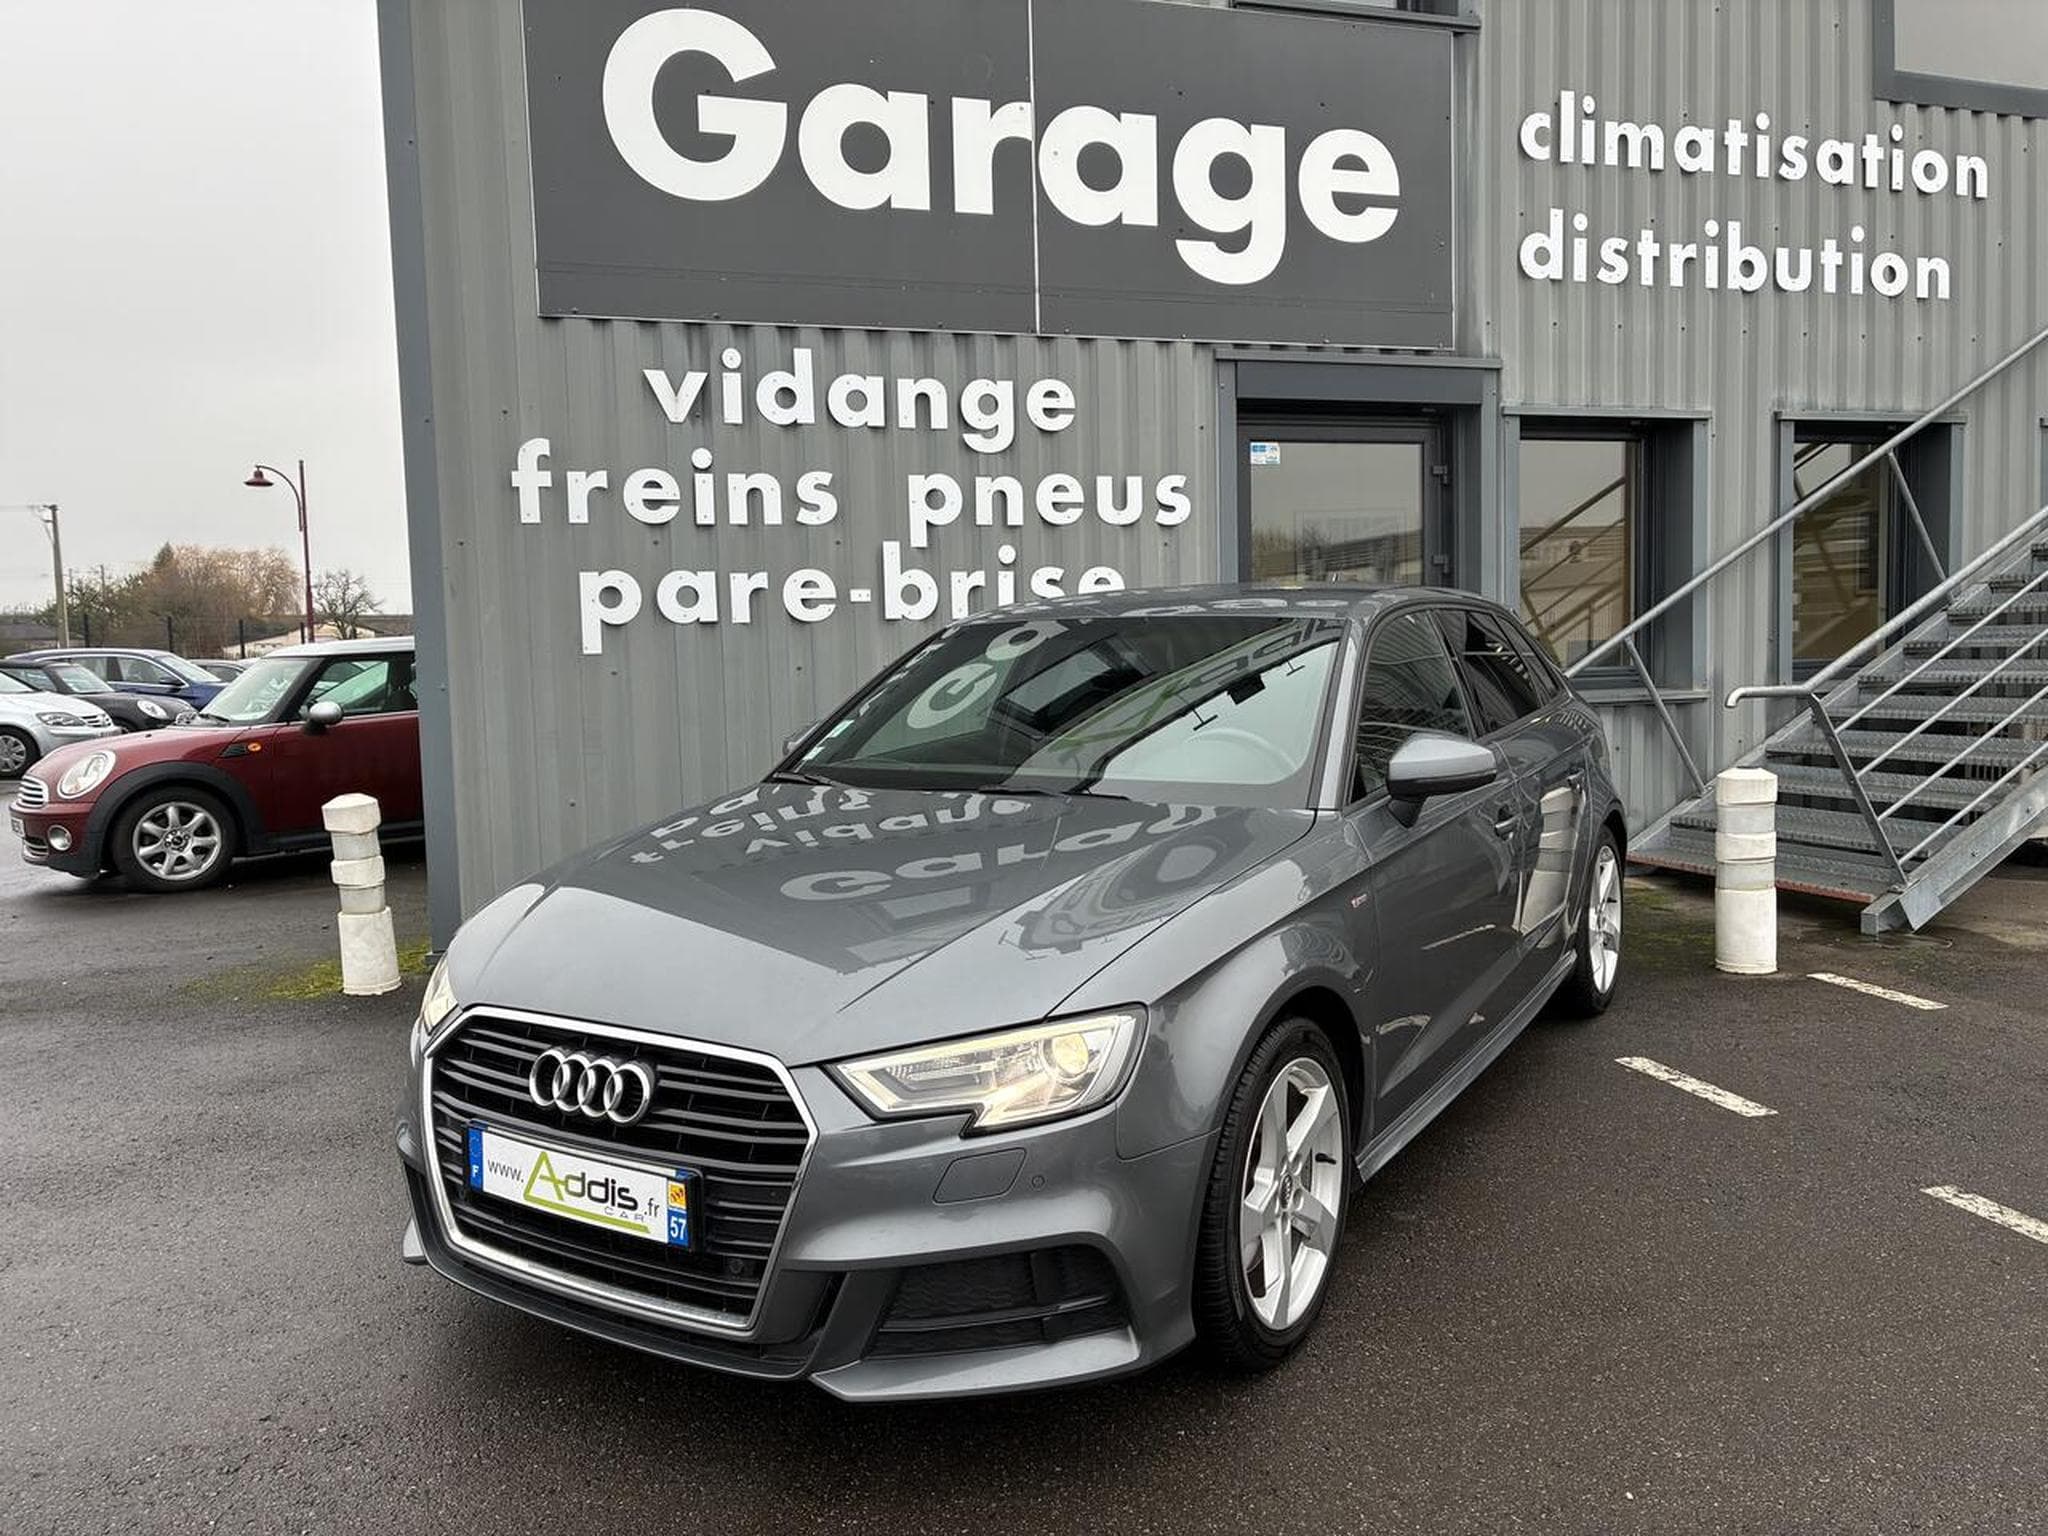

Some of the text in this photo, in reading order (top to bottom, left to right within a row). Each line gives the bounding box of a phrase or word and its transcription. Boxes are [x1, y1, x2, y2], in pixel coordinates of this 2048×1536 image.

[602, 8, 1400, 285] Garage
[1520, 90, 1988, 198] climatisation
[1519, 208, 1950, 299] distribution
[643, 347, 1076, 454] vidange
[511, 437, 1191, 547] freins pneus
[471, 1166, 480, 1177] F
[604, 1206, 645, 1221] CAR
[670, 1215, 687, 1240] 57
